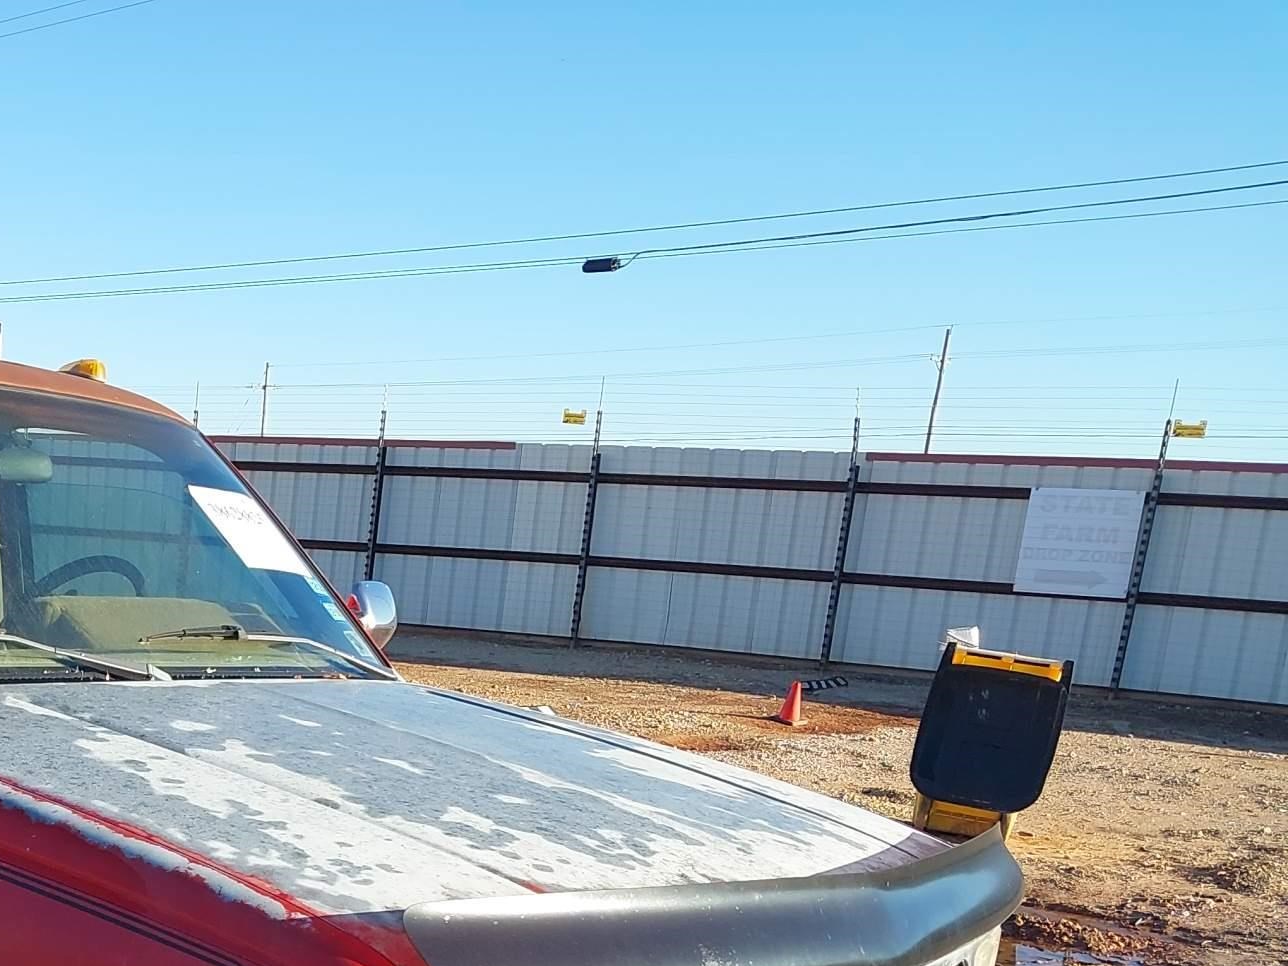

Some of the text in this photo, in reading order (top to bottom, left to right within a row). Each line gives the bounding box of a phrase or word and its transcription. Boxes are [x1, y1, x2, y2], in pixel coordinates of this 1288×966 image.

[1039, 495, 1129, 515] STATE
[1041, 523, 1120, 544] FARM
[1023, 547, 1130, 565] DROP ZONE
